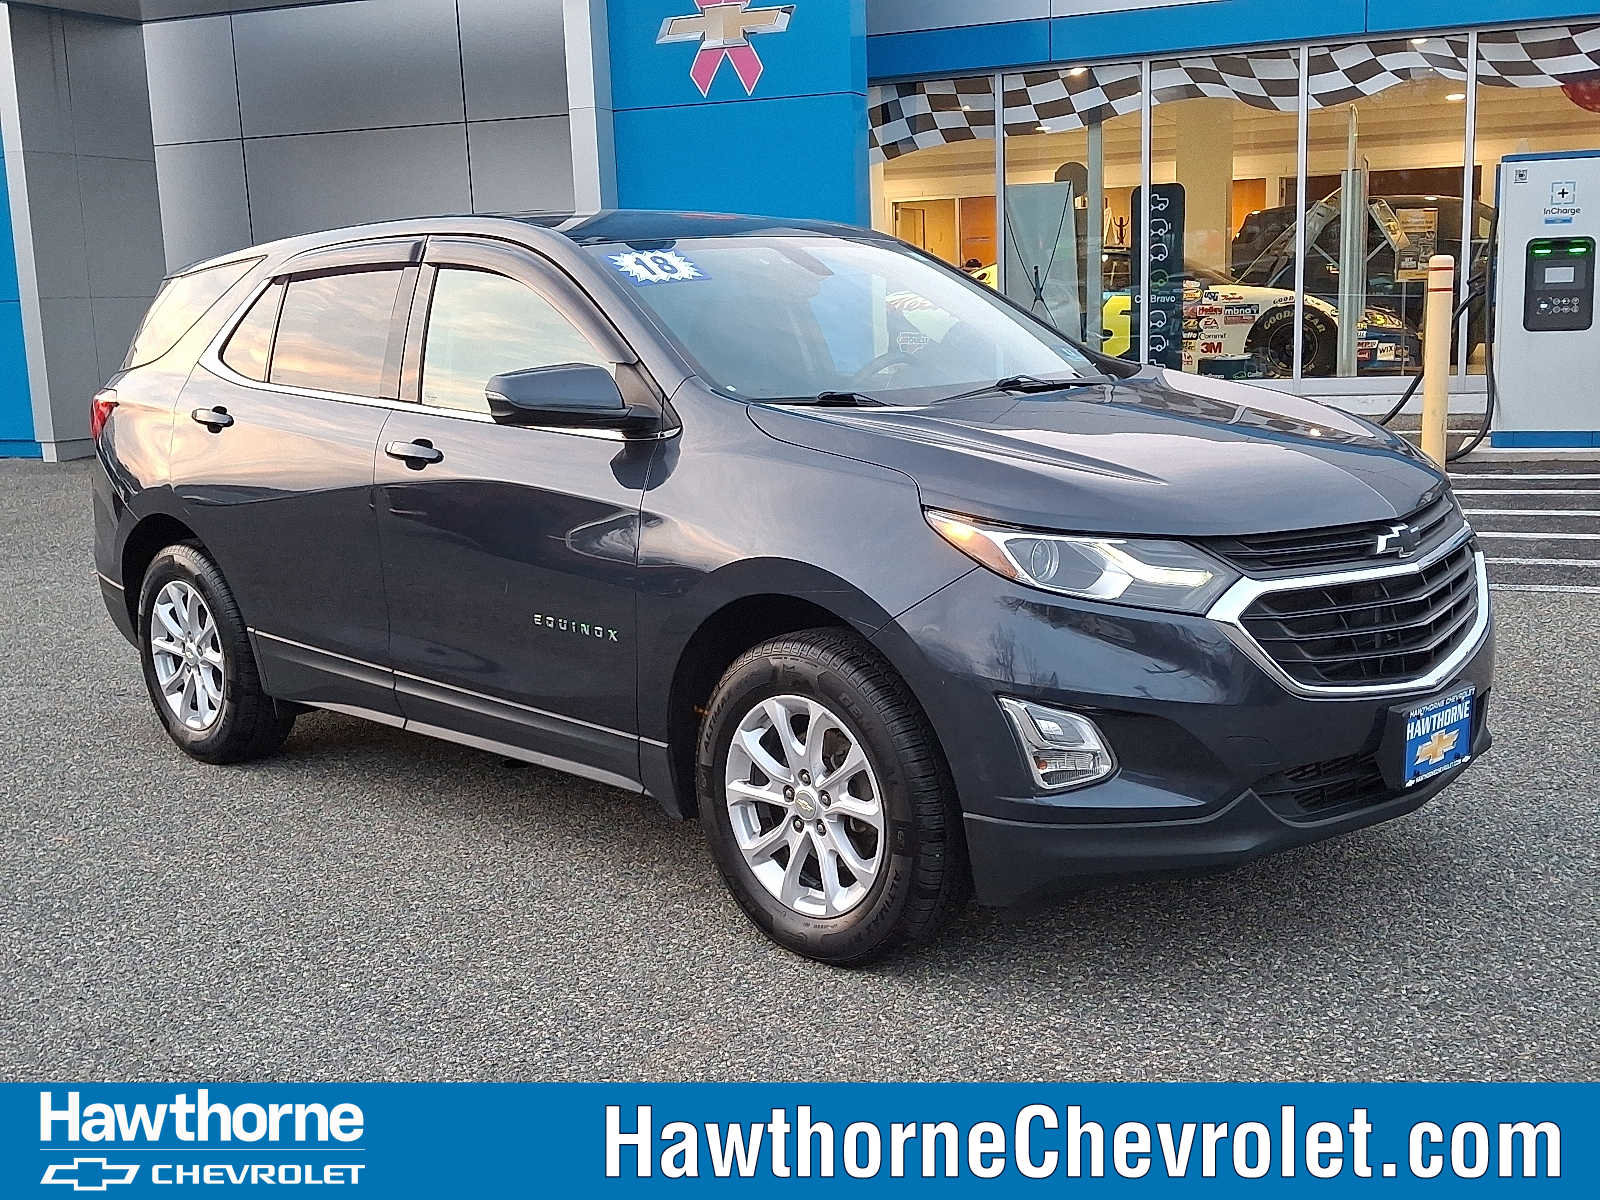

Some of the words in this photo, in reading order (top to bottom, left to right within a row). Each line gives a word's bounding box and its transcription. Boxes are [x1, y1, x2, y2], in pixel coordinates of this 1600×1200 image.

[1544, 207, 1581, 216] InCharge
[634, 255, 679, 276] 18
[1225, 306, 1252, 315] mbna
[1263, 310, 1326, 333] GOODEAR
[1200, 342, 1223, 354] 3M
[1379, 345, 1394, 354] WIX
[533, 613, 618, 642] EQUINOX
[1406, 700, 1471, 741] HAWTHORNE
